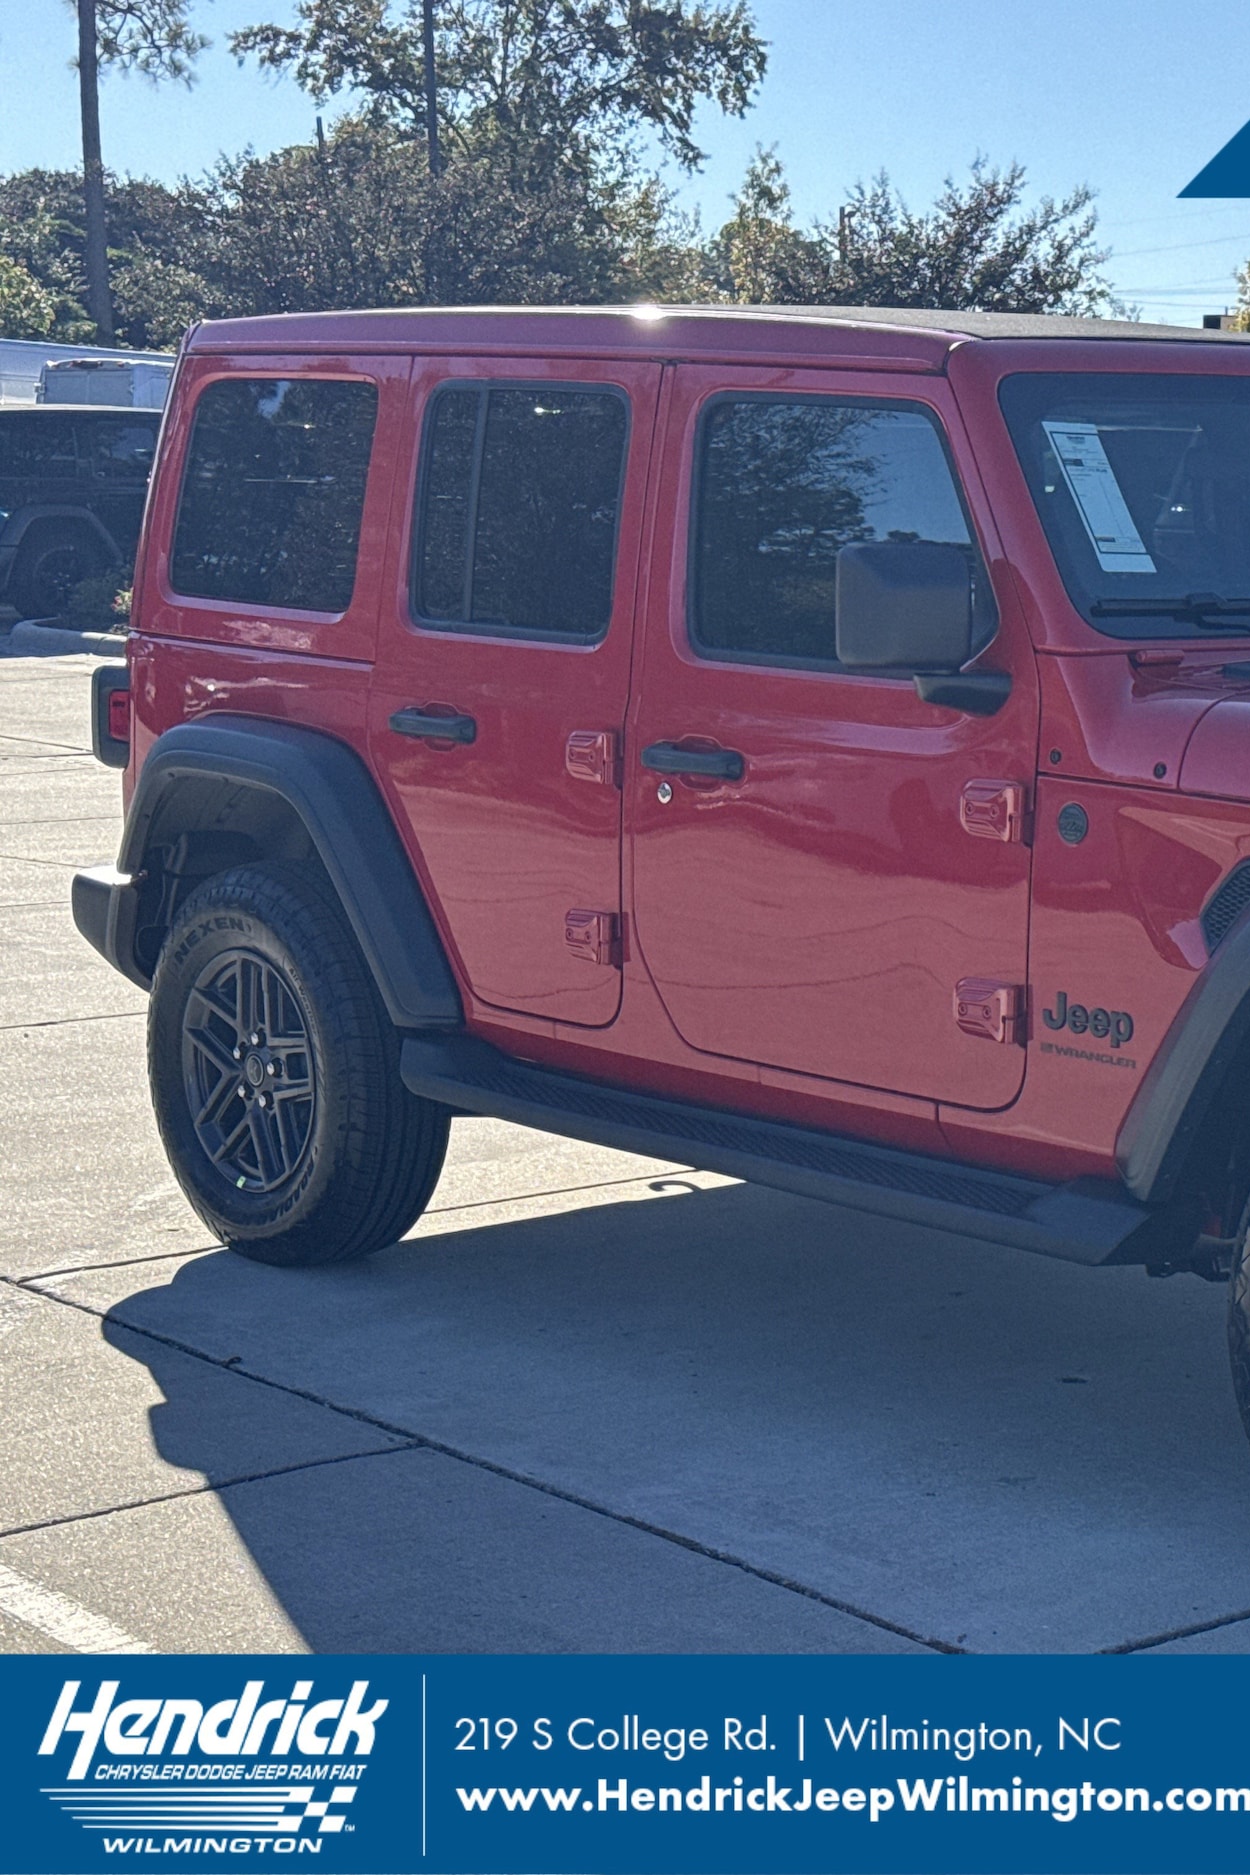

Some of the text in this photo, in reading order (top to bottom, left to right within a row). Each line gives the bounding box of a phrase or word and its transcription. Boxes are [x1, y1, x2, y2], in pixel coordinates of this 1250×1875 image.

[174, 916, 246, 965] NEXEN
[1042, 991, 1134, 1049] Jeep
[1055, 1044, 1137, 1069] WRANGLER
